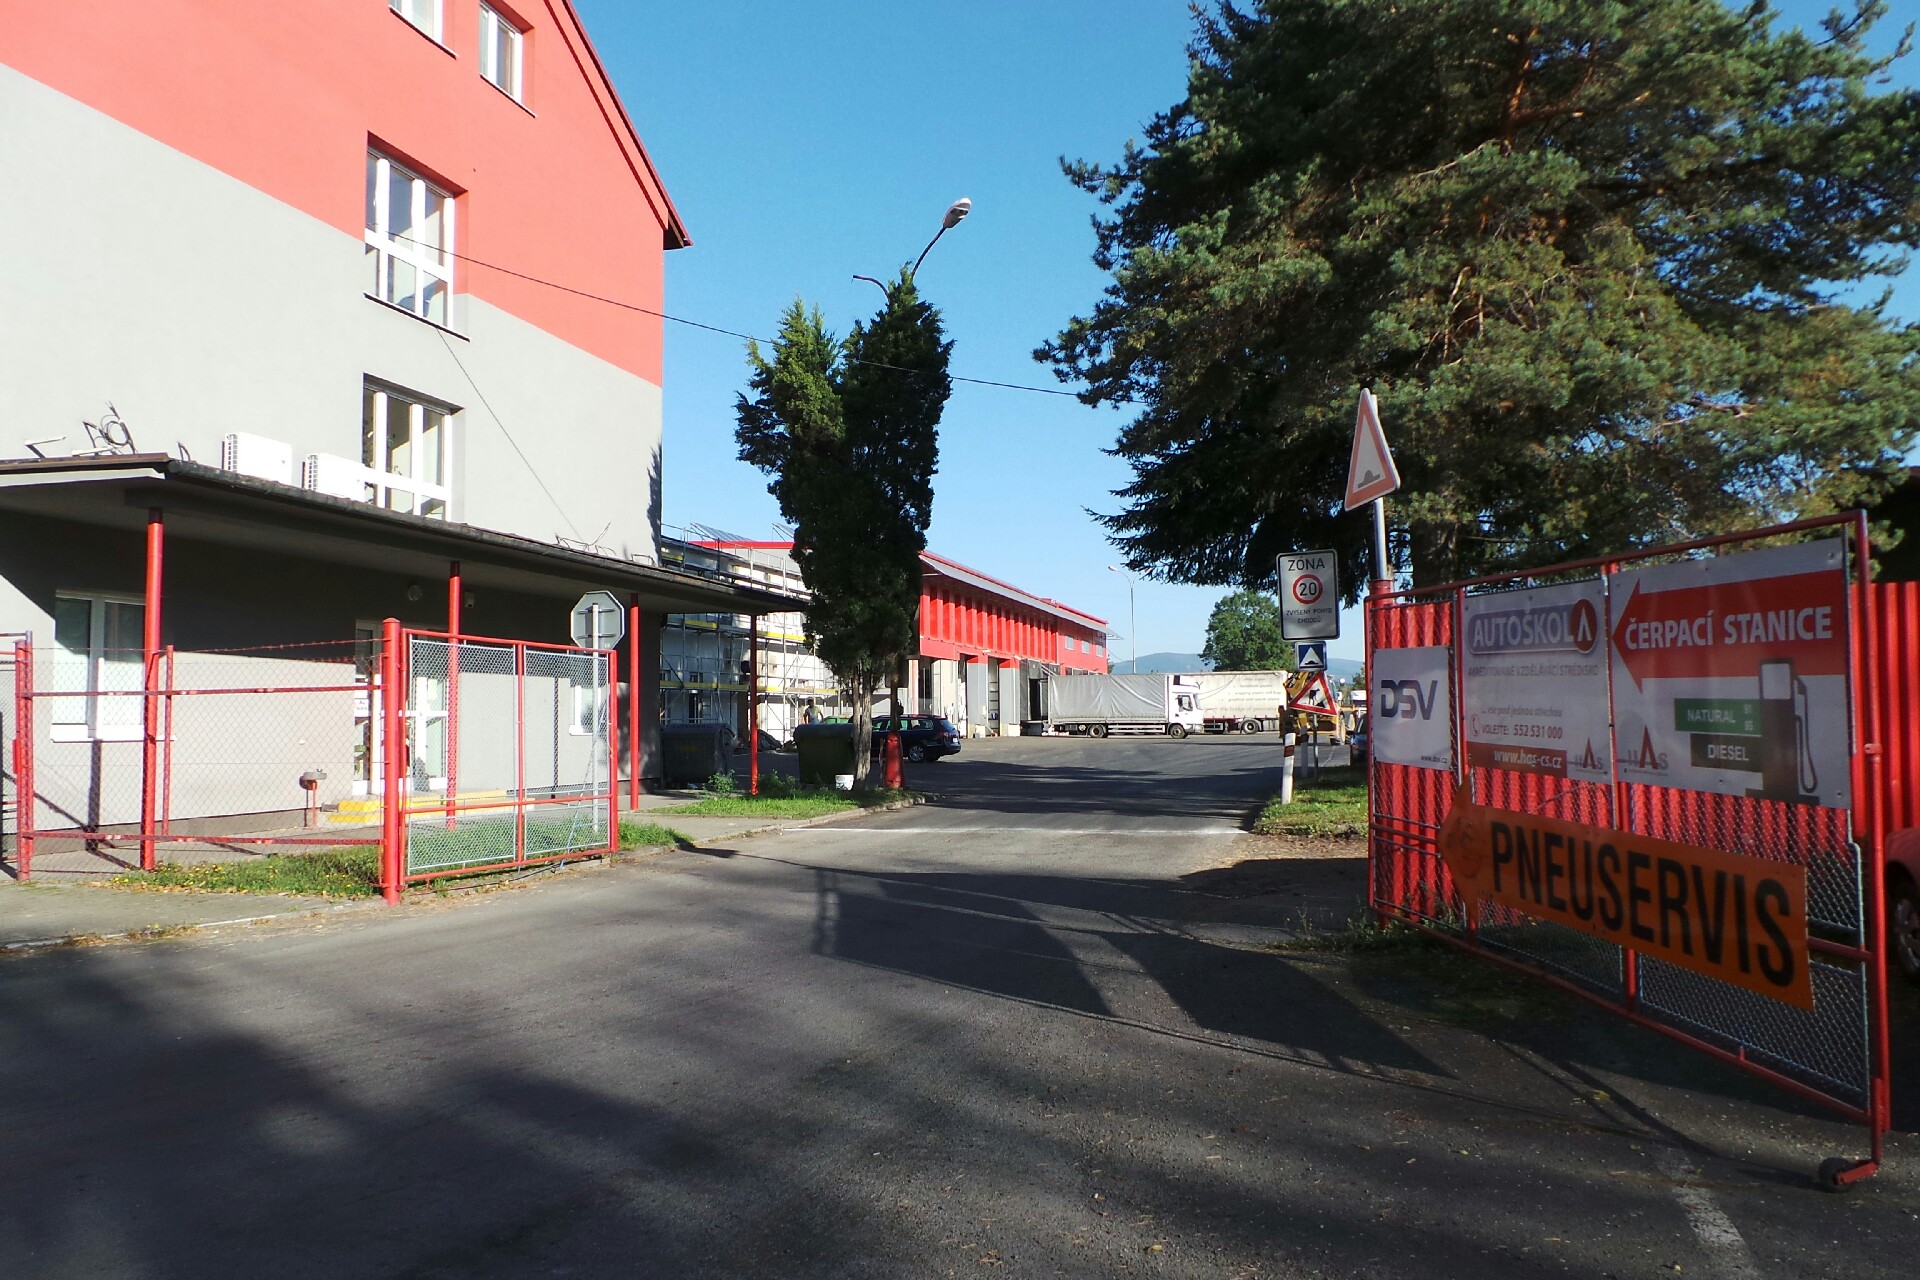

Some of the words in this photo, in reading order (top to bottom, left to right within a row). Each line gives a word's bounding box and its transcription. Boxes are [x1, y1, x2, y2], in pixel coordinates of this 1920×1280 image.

[1287, 556, 1325, 571] ZÓNA
[1299, 582, 1317, 596] 20
[1473, 606, 1592, 648] AUTOŠKOLA
[1624, 610, 1714, 650] ČERPACÍ
[1724, 605, 1834, 645] STANICE
[1380, 679, 1438, 720] DSV
[1687, 708, 1736, 724] NATURAL
[1513, 724, 1529, 737] 552
[1530, 725, 1546, 738] 531
[1547, 726, 1563, 740] 000
[1493, 749, 1563, 769] www.has-cs.cz
[1707, 744, 1750, 761] DIESEL
[1490, 821, 1796, 988] PNEUSERVIS
